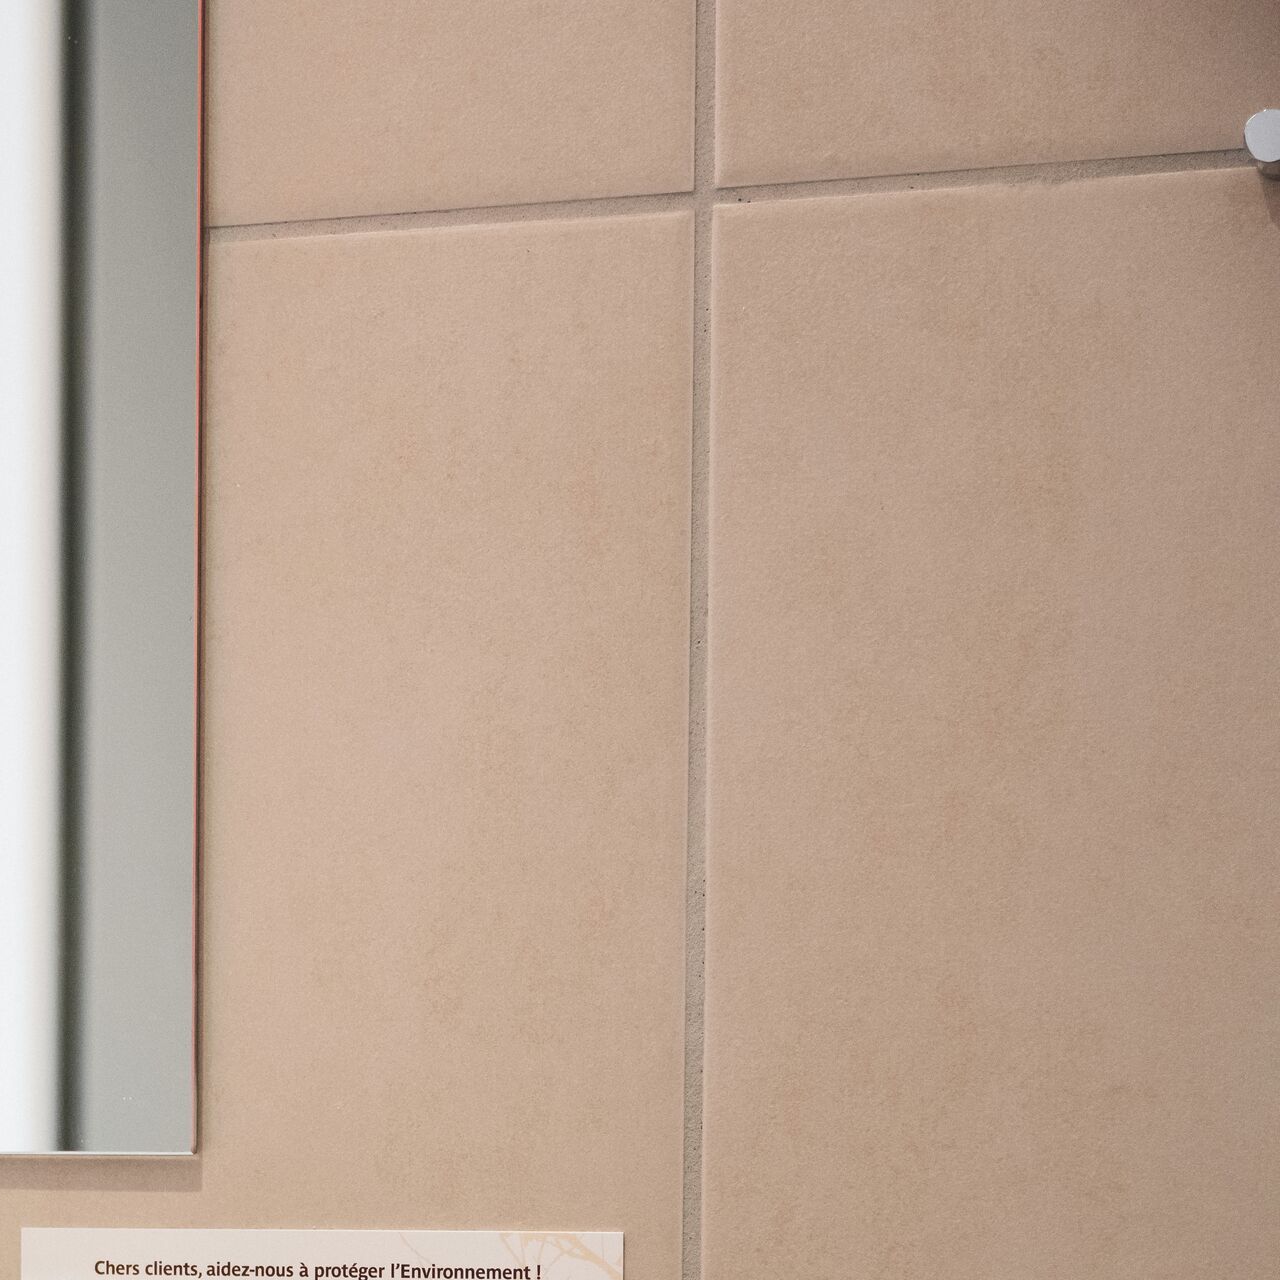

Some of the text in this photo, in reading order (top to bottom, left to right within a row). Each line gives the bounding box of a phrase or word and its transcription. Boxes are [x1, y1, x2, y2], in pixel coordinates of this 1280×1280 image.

[95, 1261, 139, 1275] Chers
[146, 1262, 202, 1279] clients,
[207, 1262, 293, 1277] aidez-nous
[300, 1263, 308, 1277] à
[315, 1263, 385, 1280] protéger
[537, 1266, 541, 1280] !
